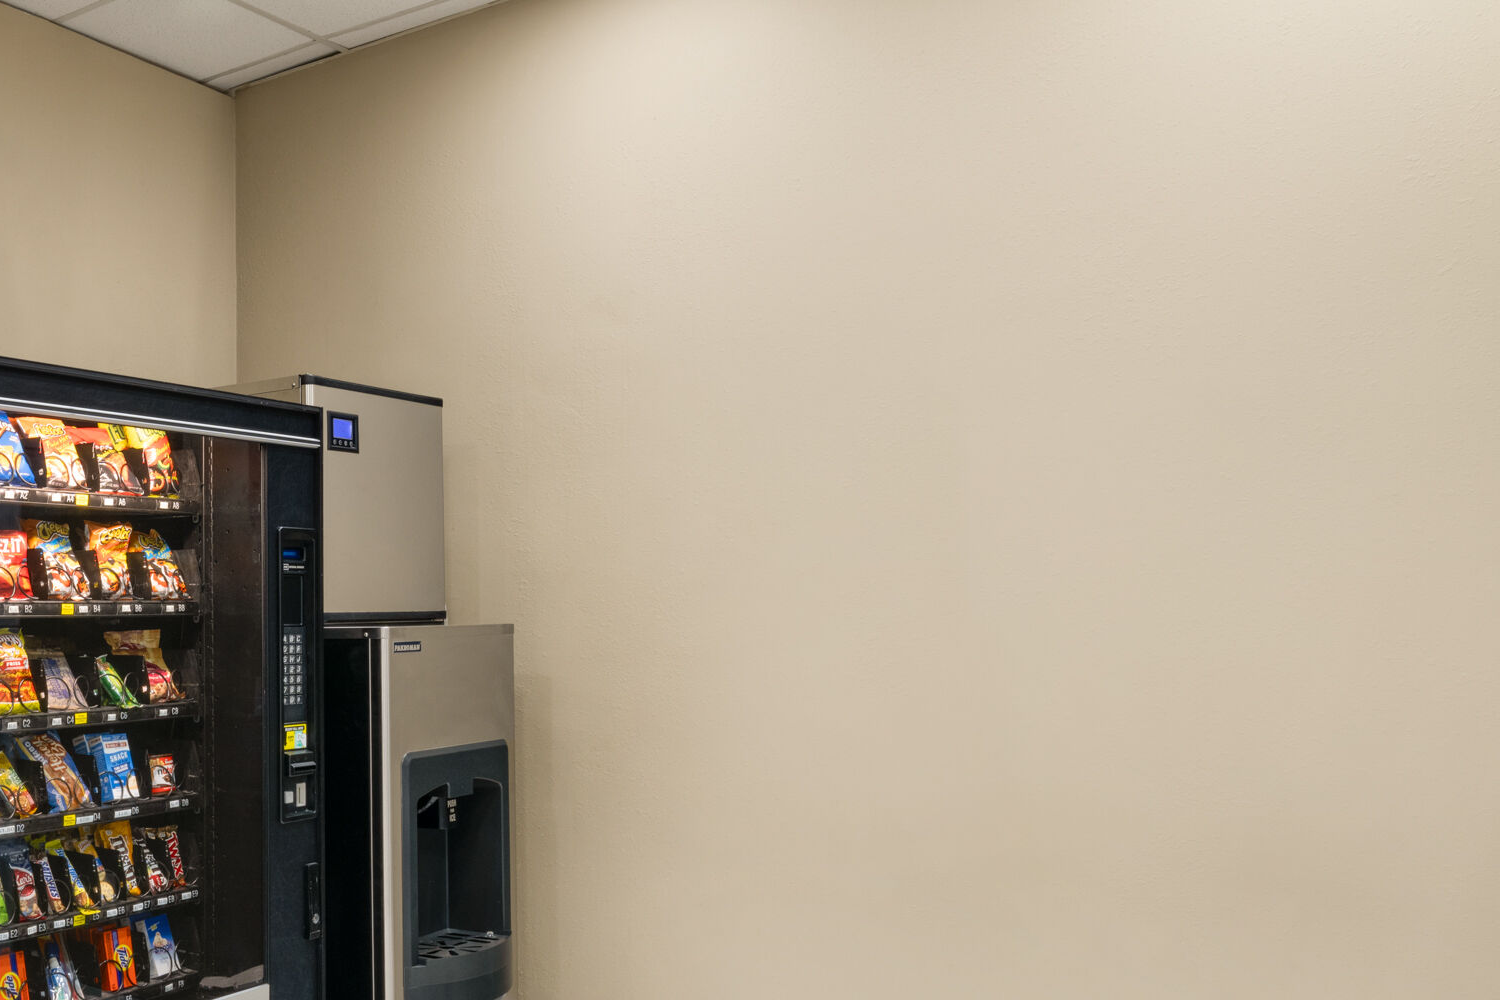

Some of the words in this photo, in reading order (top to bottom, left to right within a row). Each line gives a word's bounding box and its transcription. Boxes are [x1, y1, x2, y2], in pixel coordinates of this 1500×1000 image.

[25, 605, 32, 613] B2
[23, 719, 30, 727] C2
[110, 752, 128, 762] SNACK
[17, 824, 24, 832] D2
[166, 832, 184, 877] TWIX
[11, 929, 17, 937] E2
[117, 947, 128, 968] Tide
[5, 975, 18, 998] Tide
